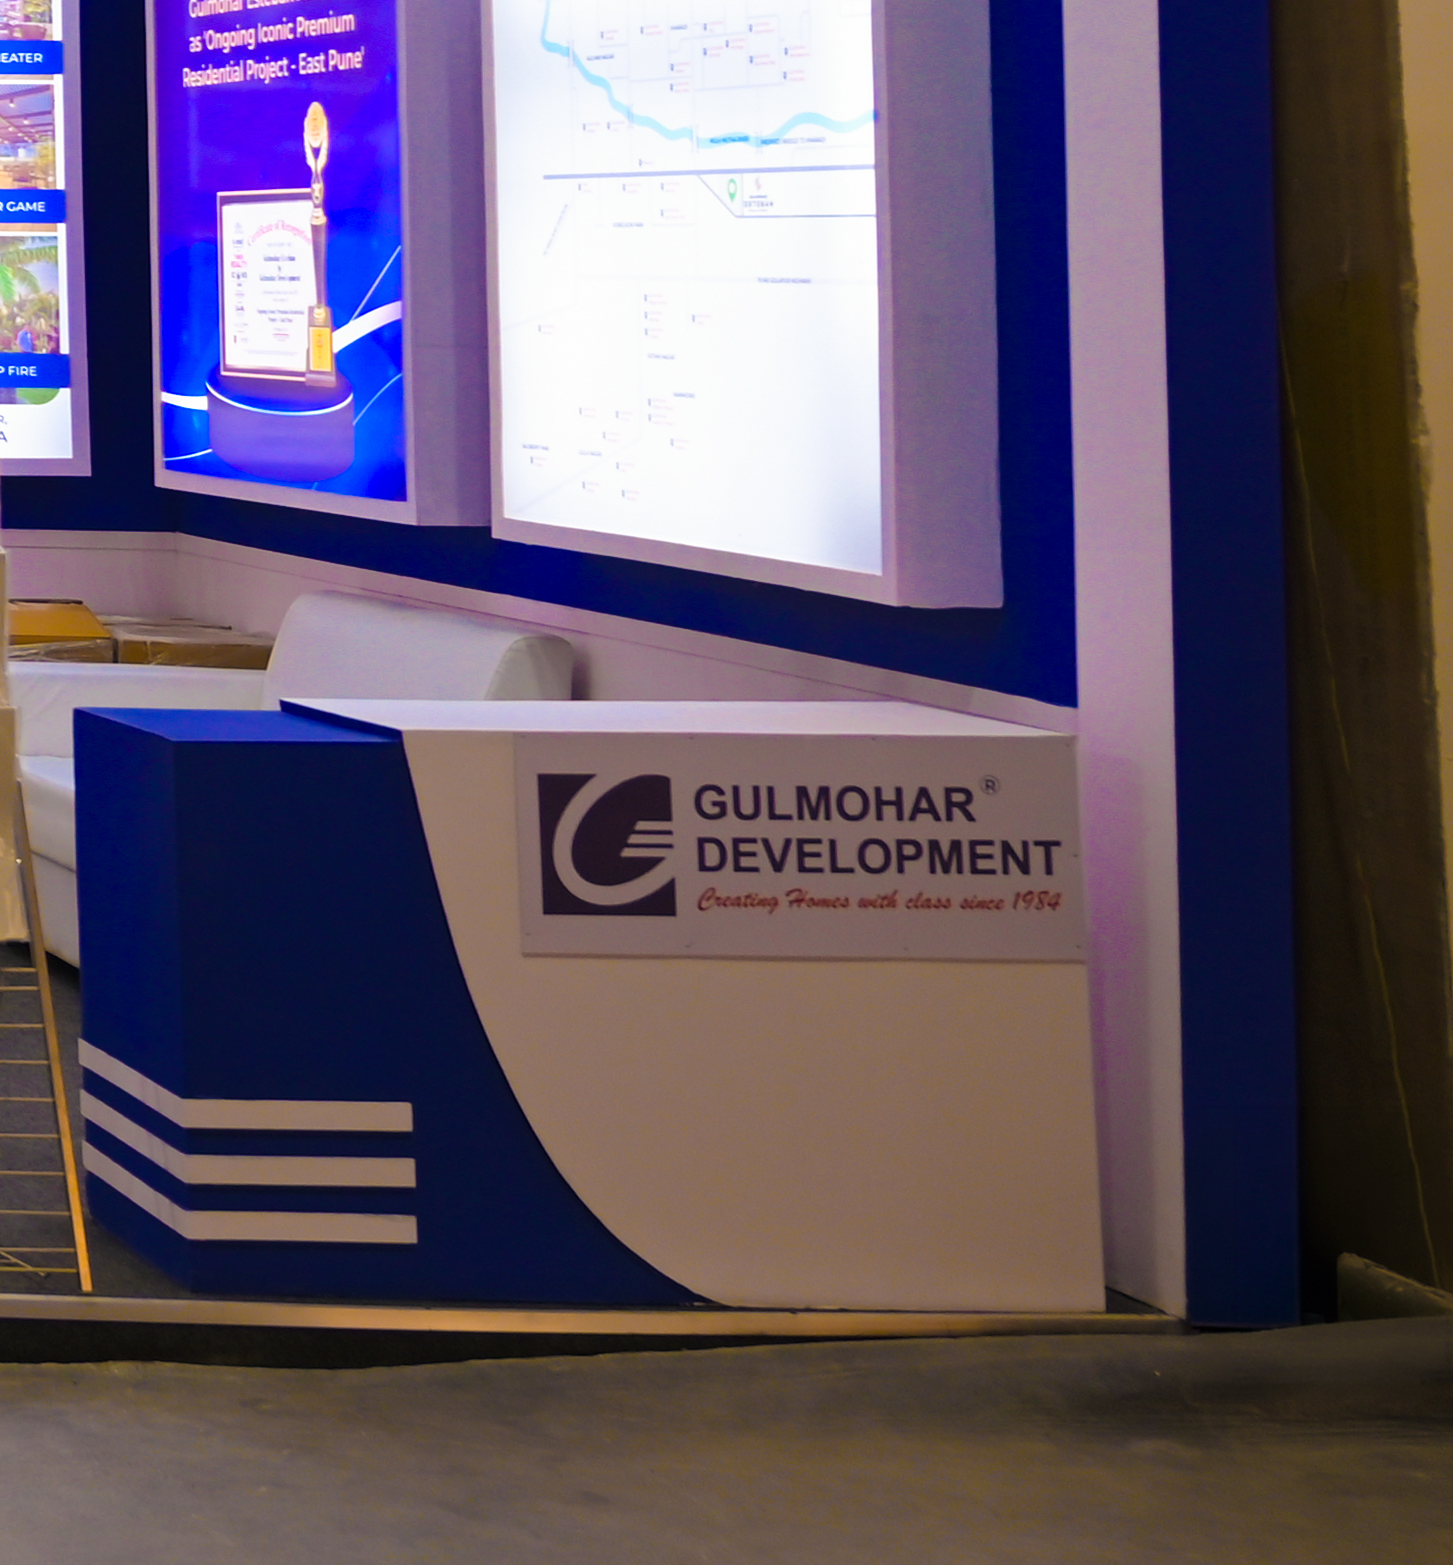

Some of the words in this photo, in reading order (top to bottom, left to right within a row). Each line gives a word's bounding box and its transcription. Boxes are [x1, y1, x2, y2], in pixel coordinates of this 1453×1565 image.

[189, 34, 202, 53] as
[258, 16, 294, 43] Iconic
[296, 10, 355, 38] Premium
[183, 59, 244, 88] Residential
[247, 55, 288, 84] Project
[299, 52, 325, 75] East
[6, 201, 45, 212] GAME
[8, 366, 37, 376] FIRE
[694, 784, 976, 822] GULMOHAR
[697, 837, 1062, 876] DEVELOPMENT
[697, 887, 779, 914] Creating
[785, 888, 850, 909] Homes
[857, 890, 898, 909] with
[905, 892, 952, 910] class
[959, 895, 1004, 911] since
[1013, 890, 1061, 911] 1984
